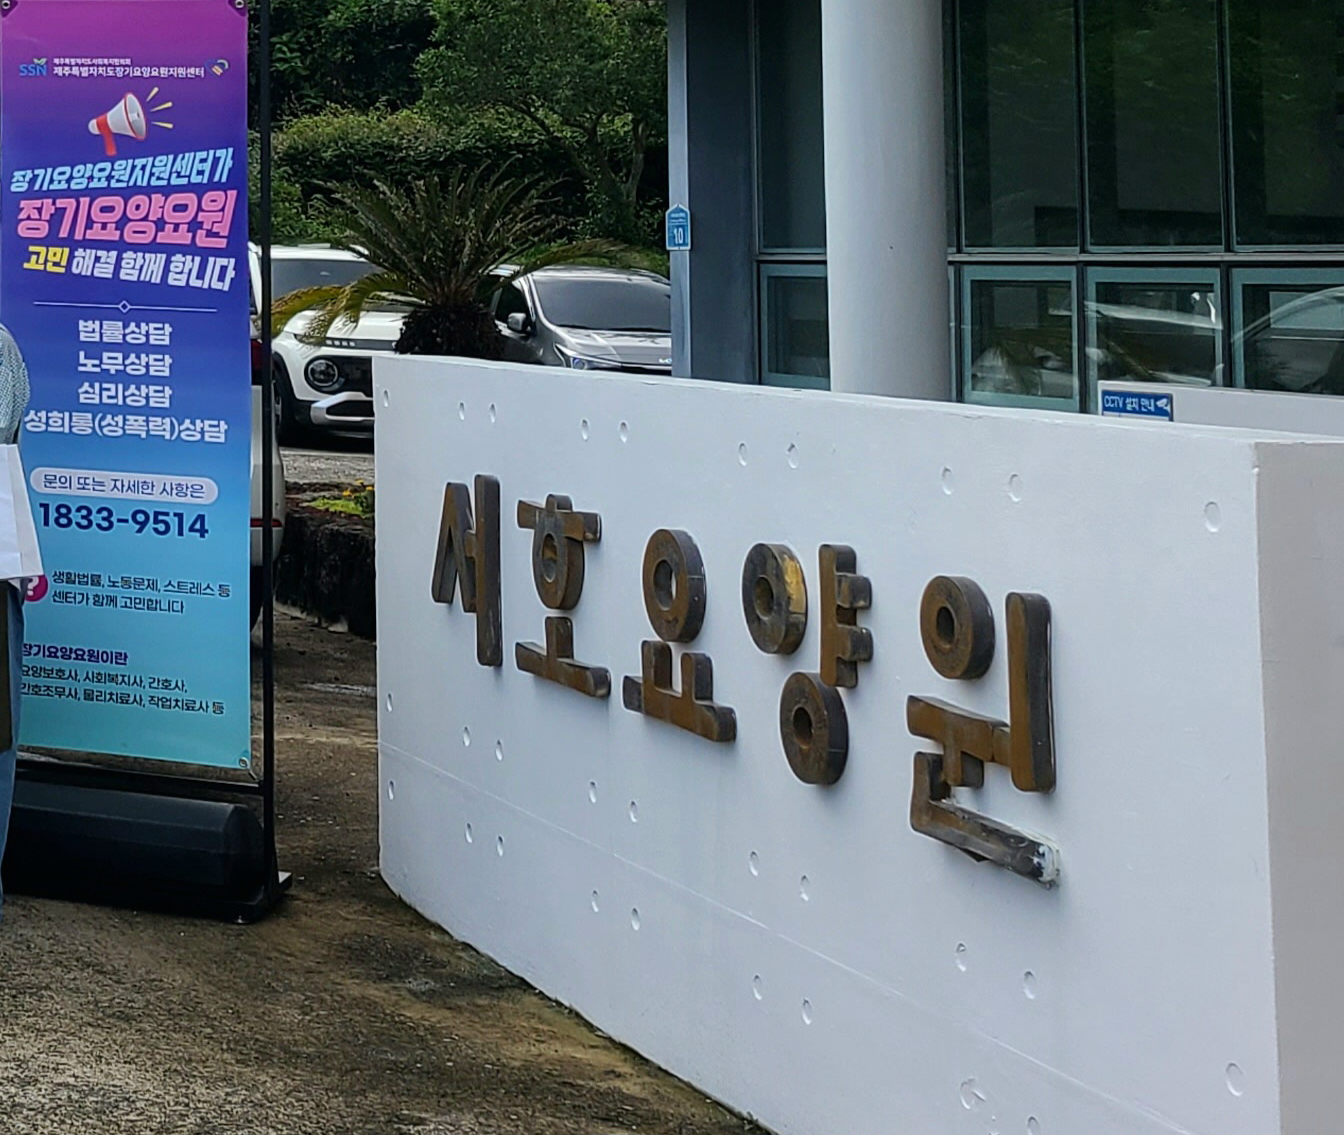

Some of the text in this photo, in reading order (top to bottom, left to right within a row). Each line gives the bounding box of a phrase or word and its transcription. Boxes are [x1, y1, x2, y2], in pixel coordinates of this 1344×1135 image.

[10, 147, 234, 193] 장기요양요원지원센터가
[16, 189, 239, 249] 장기요양요원
[673, 227, 684, 245] 10
[23, 245, 236, 292] 고민 해결 함께 합니다
[77, 319, 173, 346] 법률상담
[77, 350, 173, 377] 노무상담
[77, 381, 173, 408] 심리상담
[1103, 395, 1156, 413] CCTV 설치 안내
[23, 409, 228, 444] 성희롱(성폭력)상담
[42, 473, 206, 500] 문의 또는 자세한 사항은
[38, 502, 210, 539] 1833-9514
[51, 570, 232, 599] 생활법률, 노동문제, 스트레스 등
[51, 589, 185, 615] 센터가 함께 고민합니다
[82, 670, 147, 691] 사회복지사,
[148, 676, 188, 694] 간호사,
[431, 473, 1061, 889] 서호요양원
[82, 688, 147, 709] 물리치료사,
[148, 694, 210, 715] 작업치료사
[212, 700, 226, 715] 등
